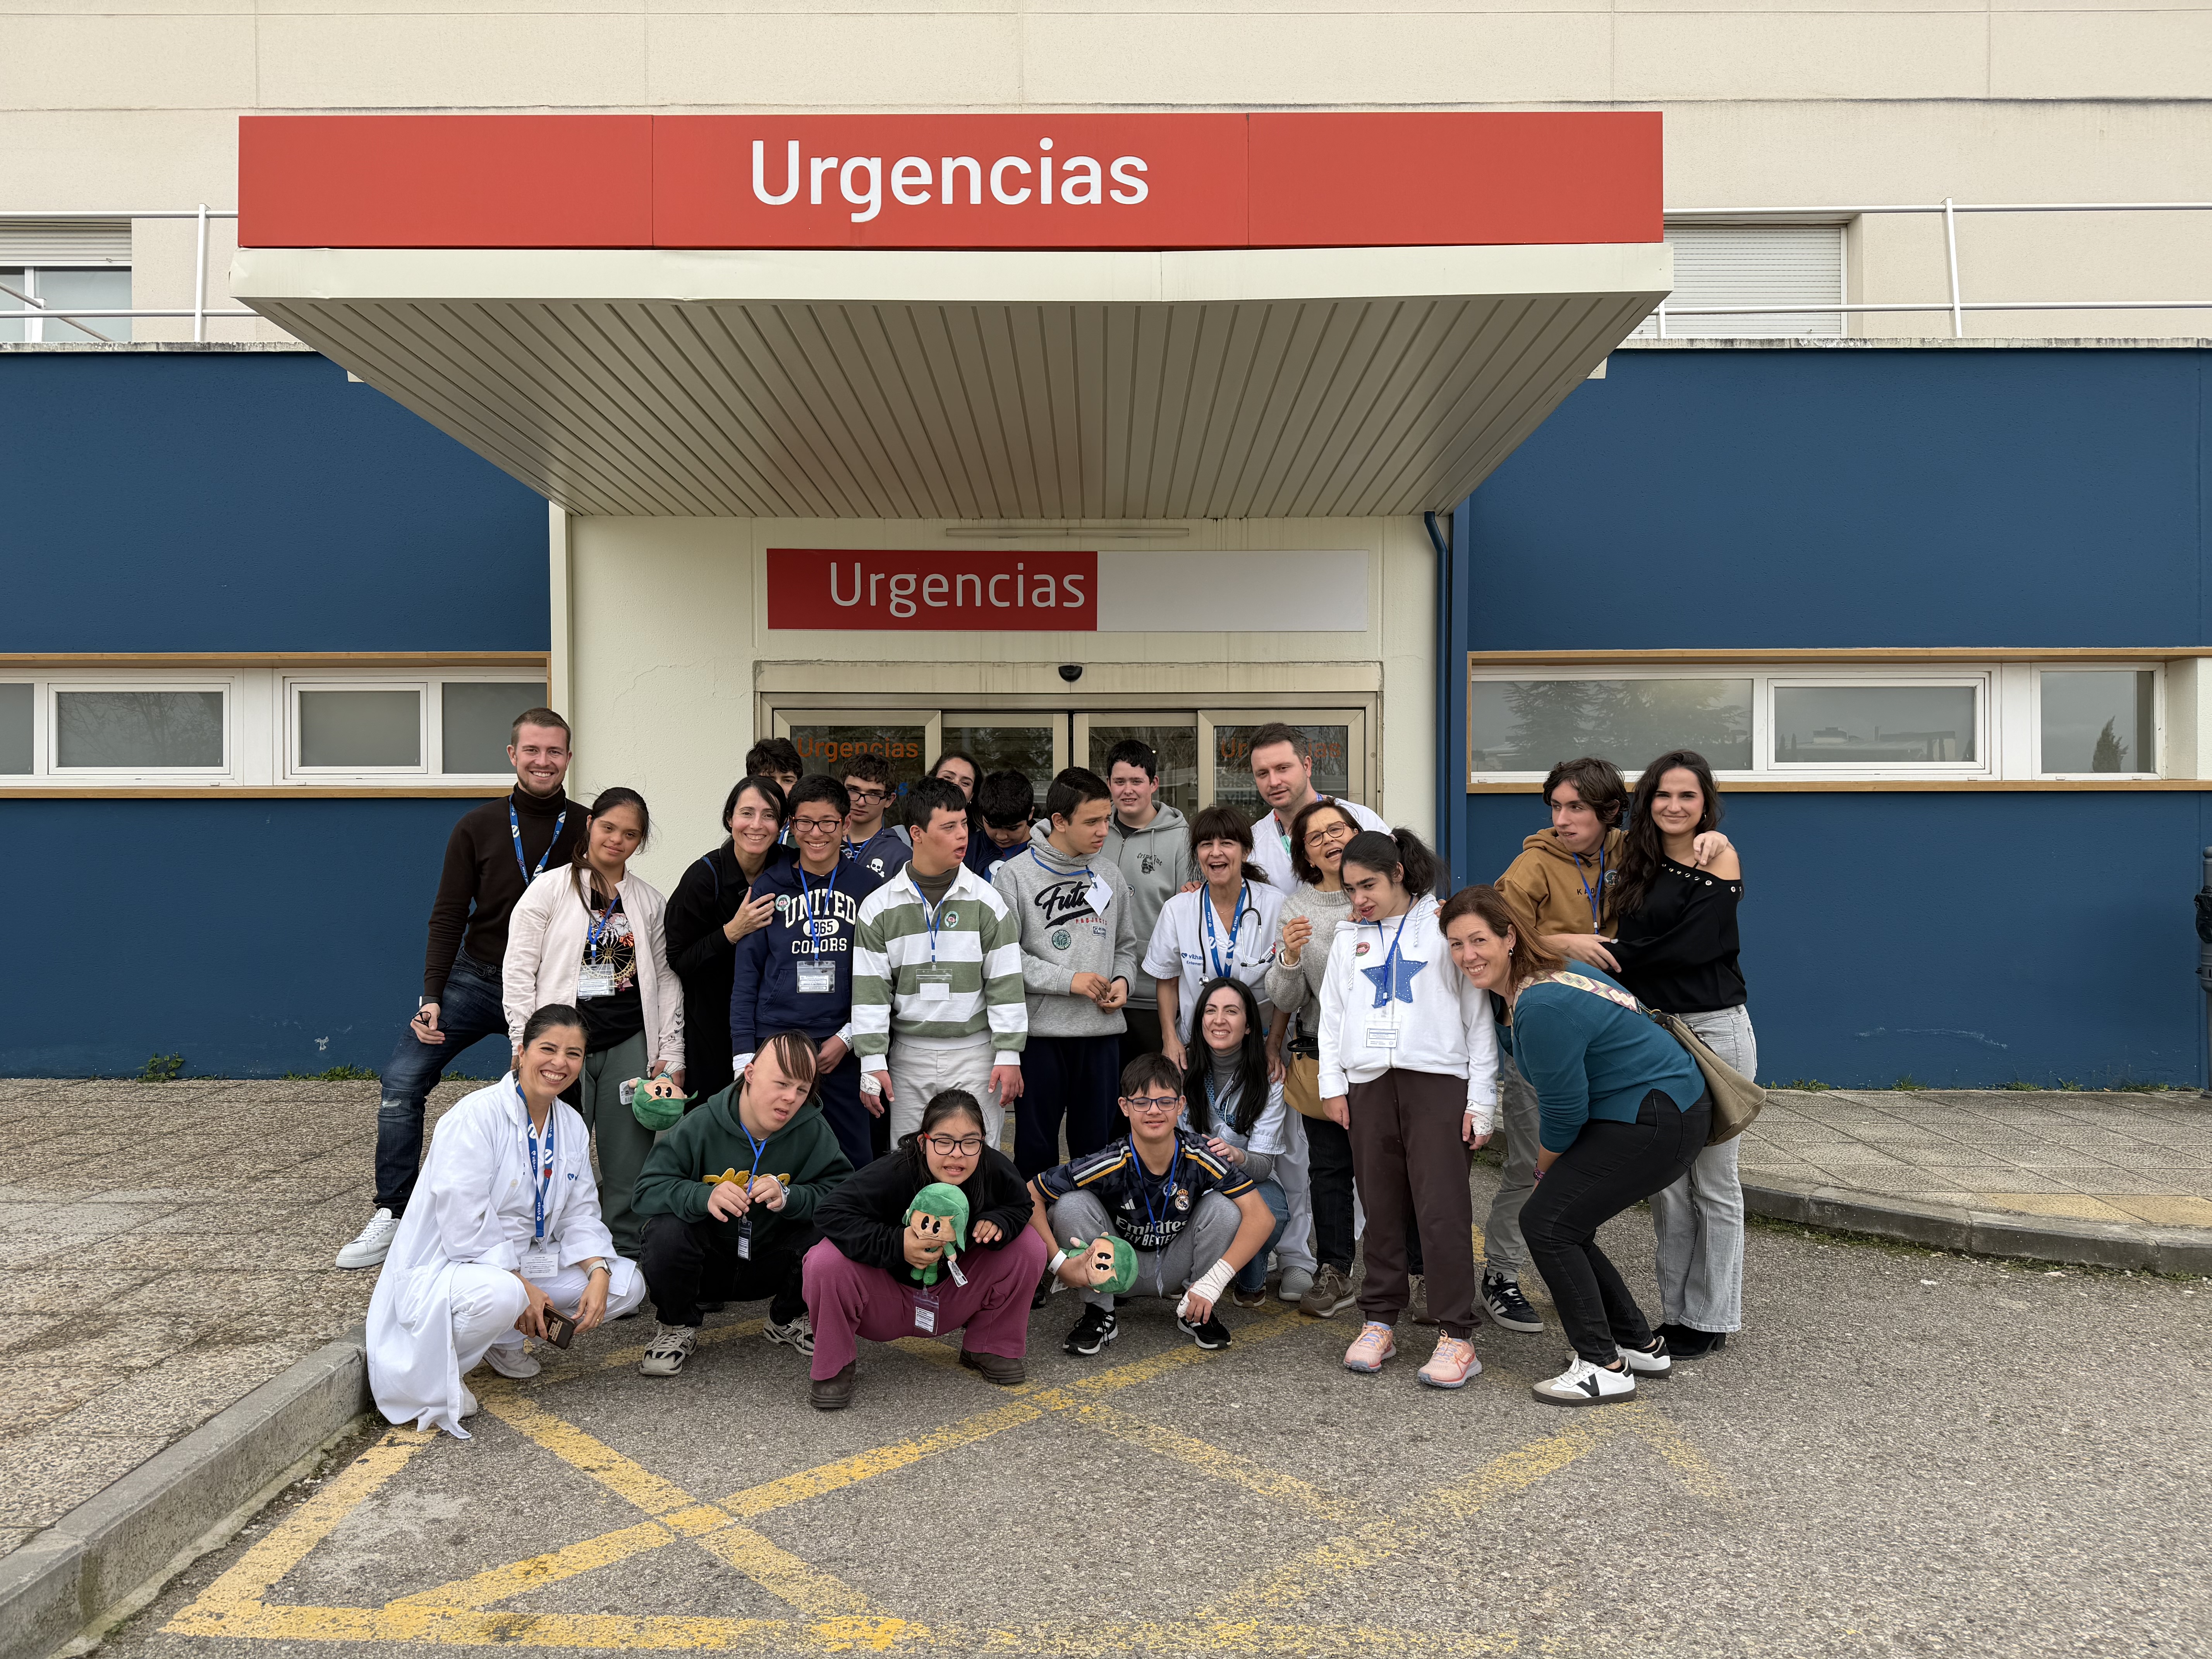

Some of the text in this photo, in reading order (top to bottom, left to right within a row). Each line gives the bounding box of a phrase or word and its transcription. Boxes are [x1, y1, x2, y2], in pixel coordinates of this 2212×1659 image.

[752, 137, 1148, 223] Urgencias
[831, 562, 1084, 617] Urgencias
[798, 737, 919, 762] Urgencias
[1221, 737, 1341, 758] Urias
[785, 889, 856, 928] UNITED
[1116, 1215, 1187, 1235] Emirates
[1124, 1232, 1177, 1246] FLY BETER
